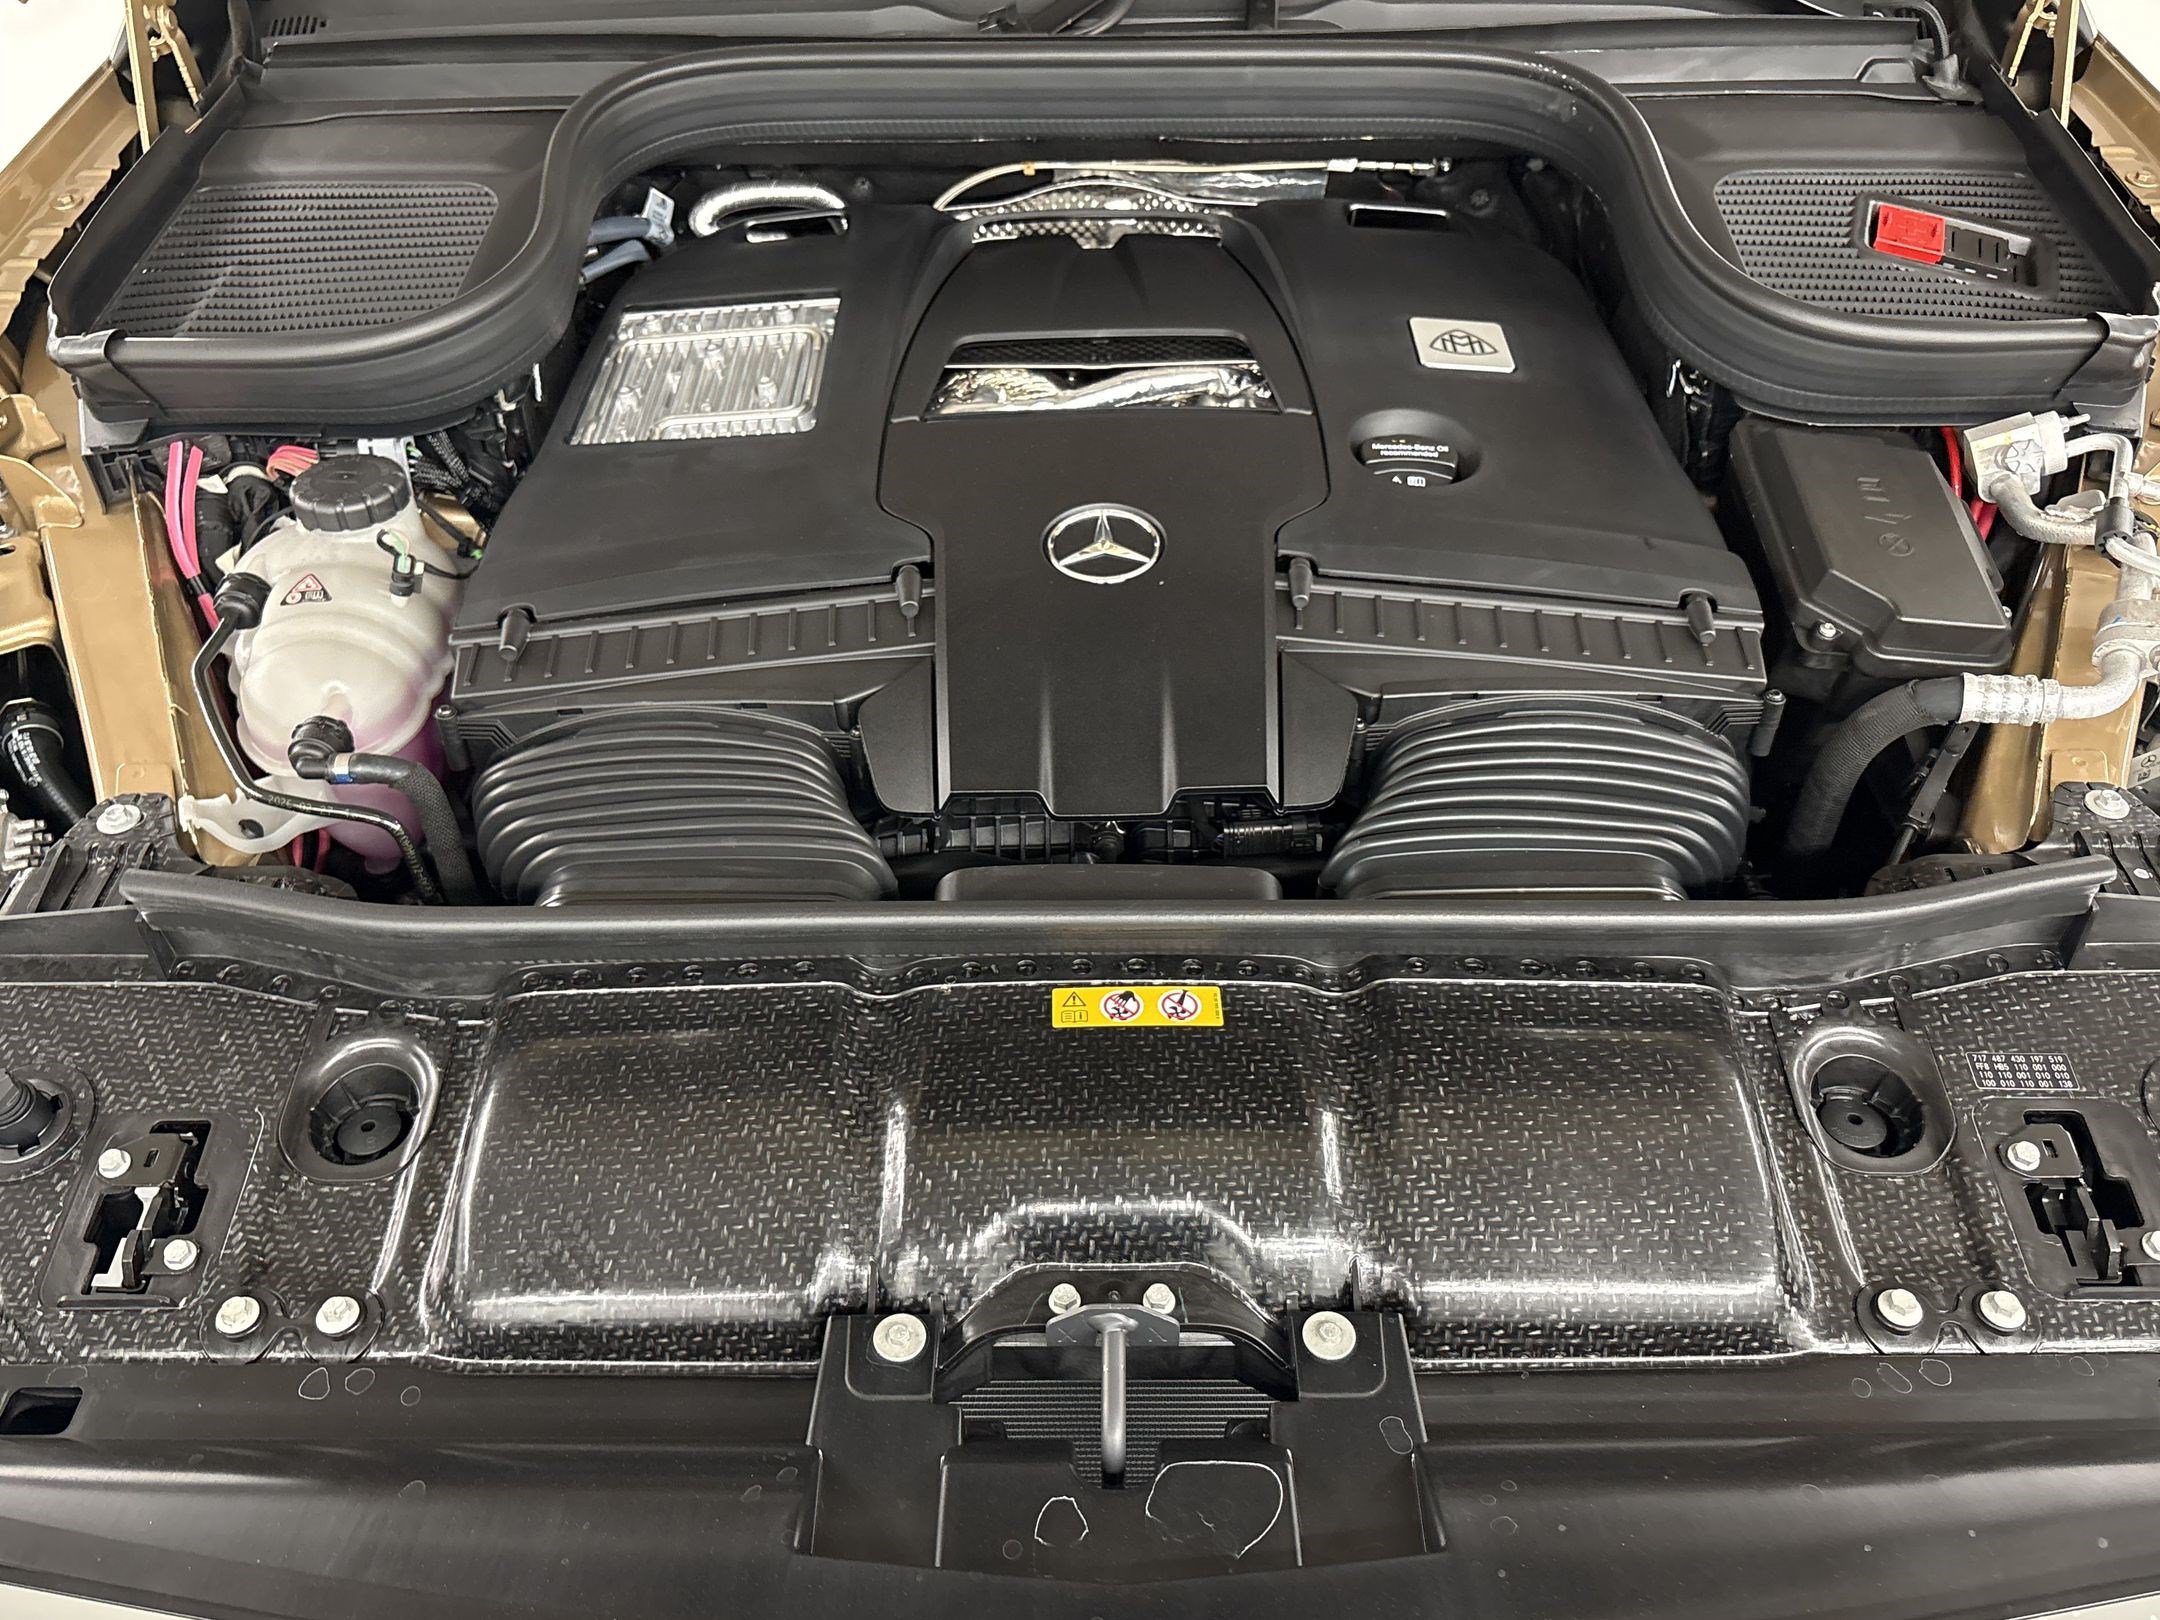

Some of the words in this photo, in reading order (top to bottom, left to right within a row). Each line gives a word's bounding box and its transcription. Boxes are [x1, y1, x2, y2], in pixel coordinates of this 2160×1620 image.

[1380, 450, 1439, 458] recommended
[1972, 1054, 1986, 1062] 717
[2011, 1055, 2025, 1063] 430
[2030, 1055, 2043, 1063] 197
[2048, 1055, 2063, 1063] 519
[2014, 1063, 2029, 1071] 110
[2032, 1063, 2047, 1071] 001
[2051, 1063, 2067, 1071] 000
[1979, 1071, 1993, 1079] 110
[1998, 1071, 2012, 1079] 110
[2016, 1071, 2031, 1079] 001
[2035, 1071, 2050, 1079] 010
[2054, 1071, 2070, 1080] 010
[1982, 1079, 1996, 1087] 100
[2000, 1079, 2015, 1087] 010
[2038, 1080, 2053, 1088] 001
